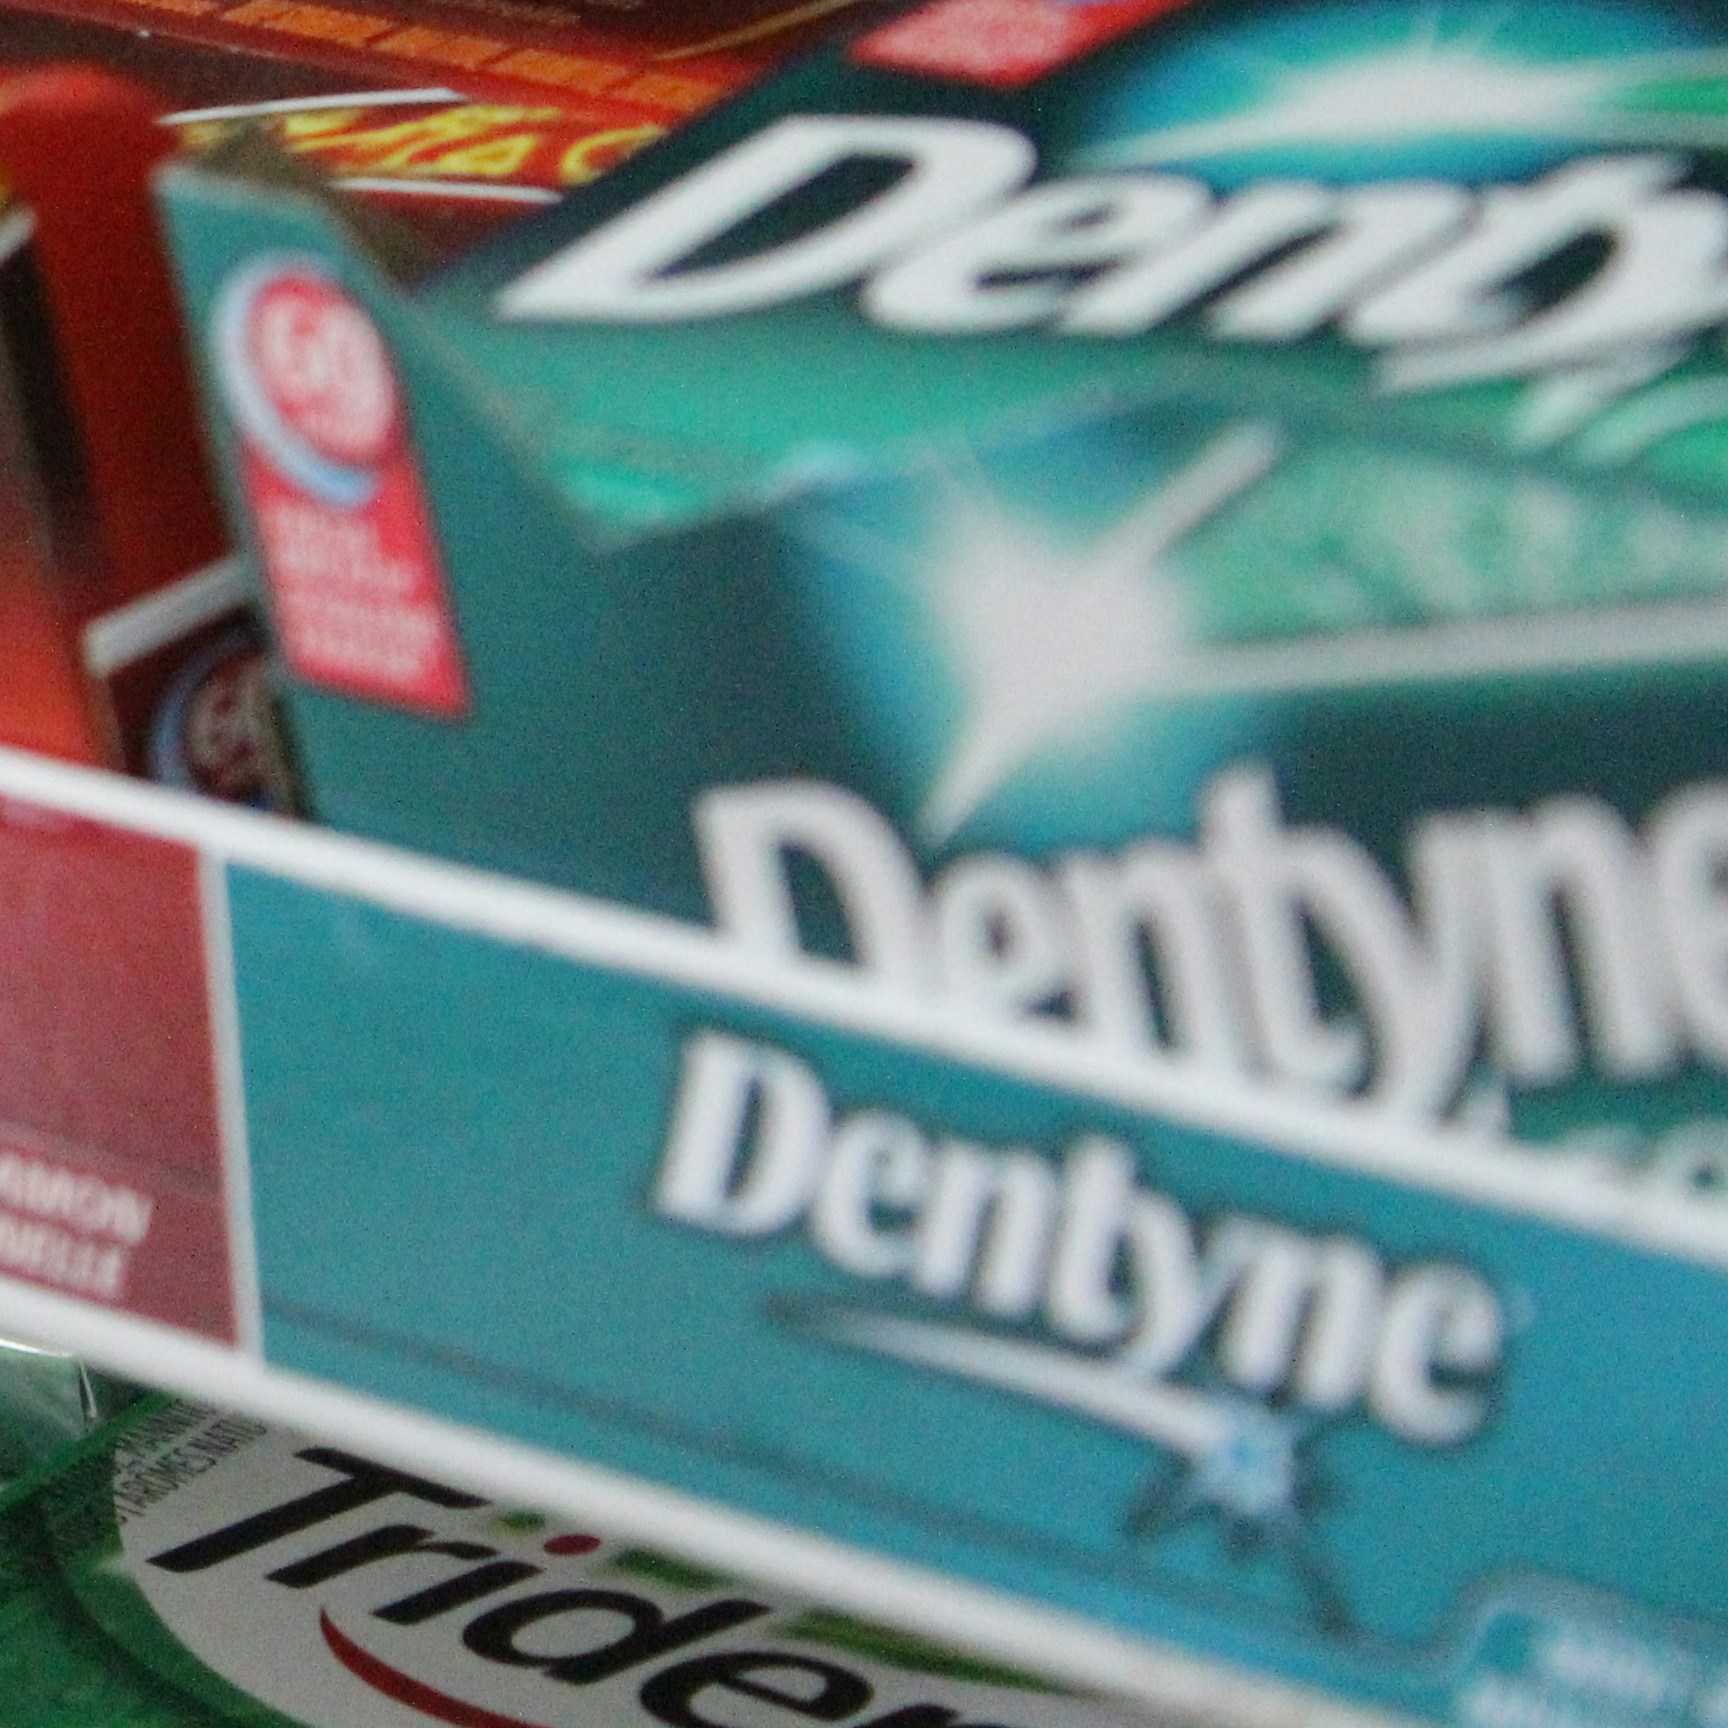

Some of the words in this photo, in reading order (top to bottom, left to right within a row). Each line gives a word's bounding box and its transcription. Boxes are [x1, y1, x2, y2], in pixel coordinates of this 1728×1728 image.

[497, 114, 1728, 394] Denty
[650, 1027, 1509, 1451] Dentyne
[146, 1447, 1034, 1728] Tride
